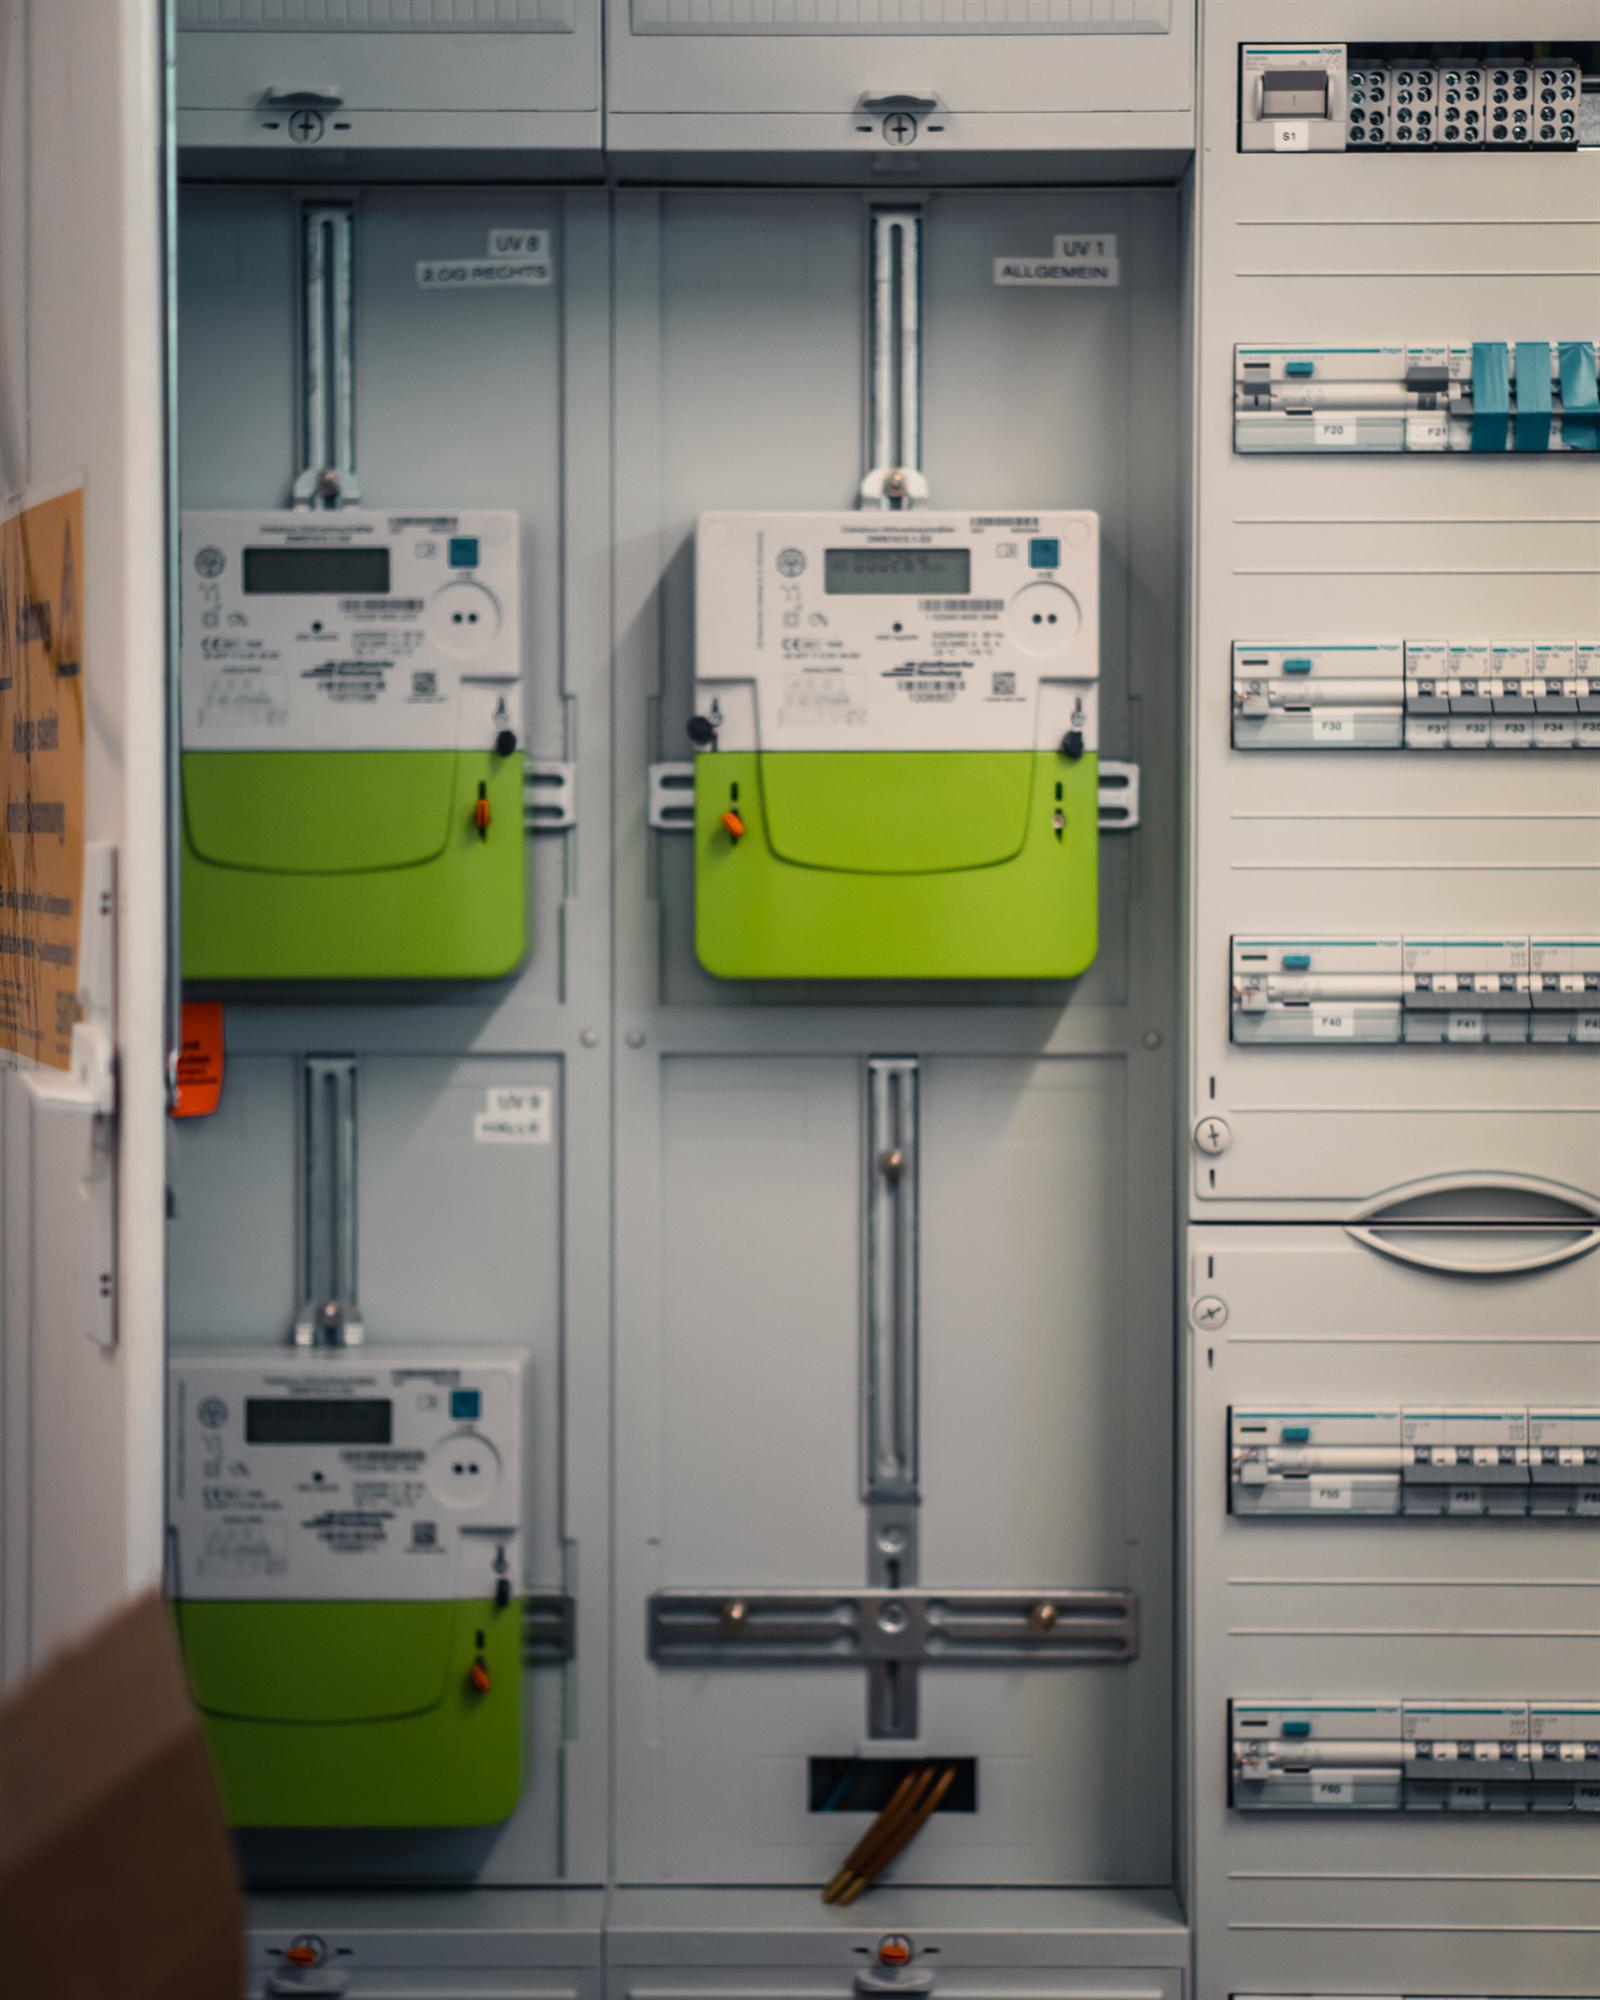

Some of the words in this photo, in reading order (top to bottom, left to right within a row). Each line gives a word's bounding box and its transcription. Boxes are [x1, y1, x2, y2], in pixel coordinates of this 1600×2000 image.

[1282, 131, 1297, 142] S1
[495, 235, 524, 252] UV
[1062, 240, 1091, 257] UV
[471, 265, 547, 280] RECHTS
[1001, 264, 1109, 280] ALLGEMEIN
[1323, 424, 1345, 436] F20
[1428, 427, 1447, 438] F21
[1321, 720, 1343, 732] F30
[1427, 724, 1448, 735] F31
[1466, 724, 1486, 734] F32
[1543, 722, 1564, 733] F34
[1321, 1016, 1342, 1028] F40
[1456, 1019, 1477, 1030] F41
